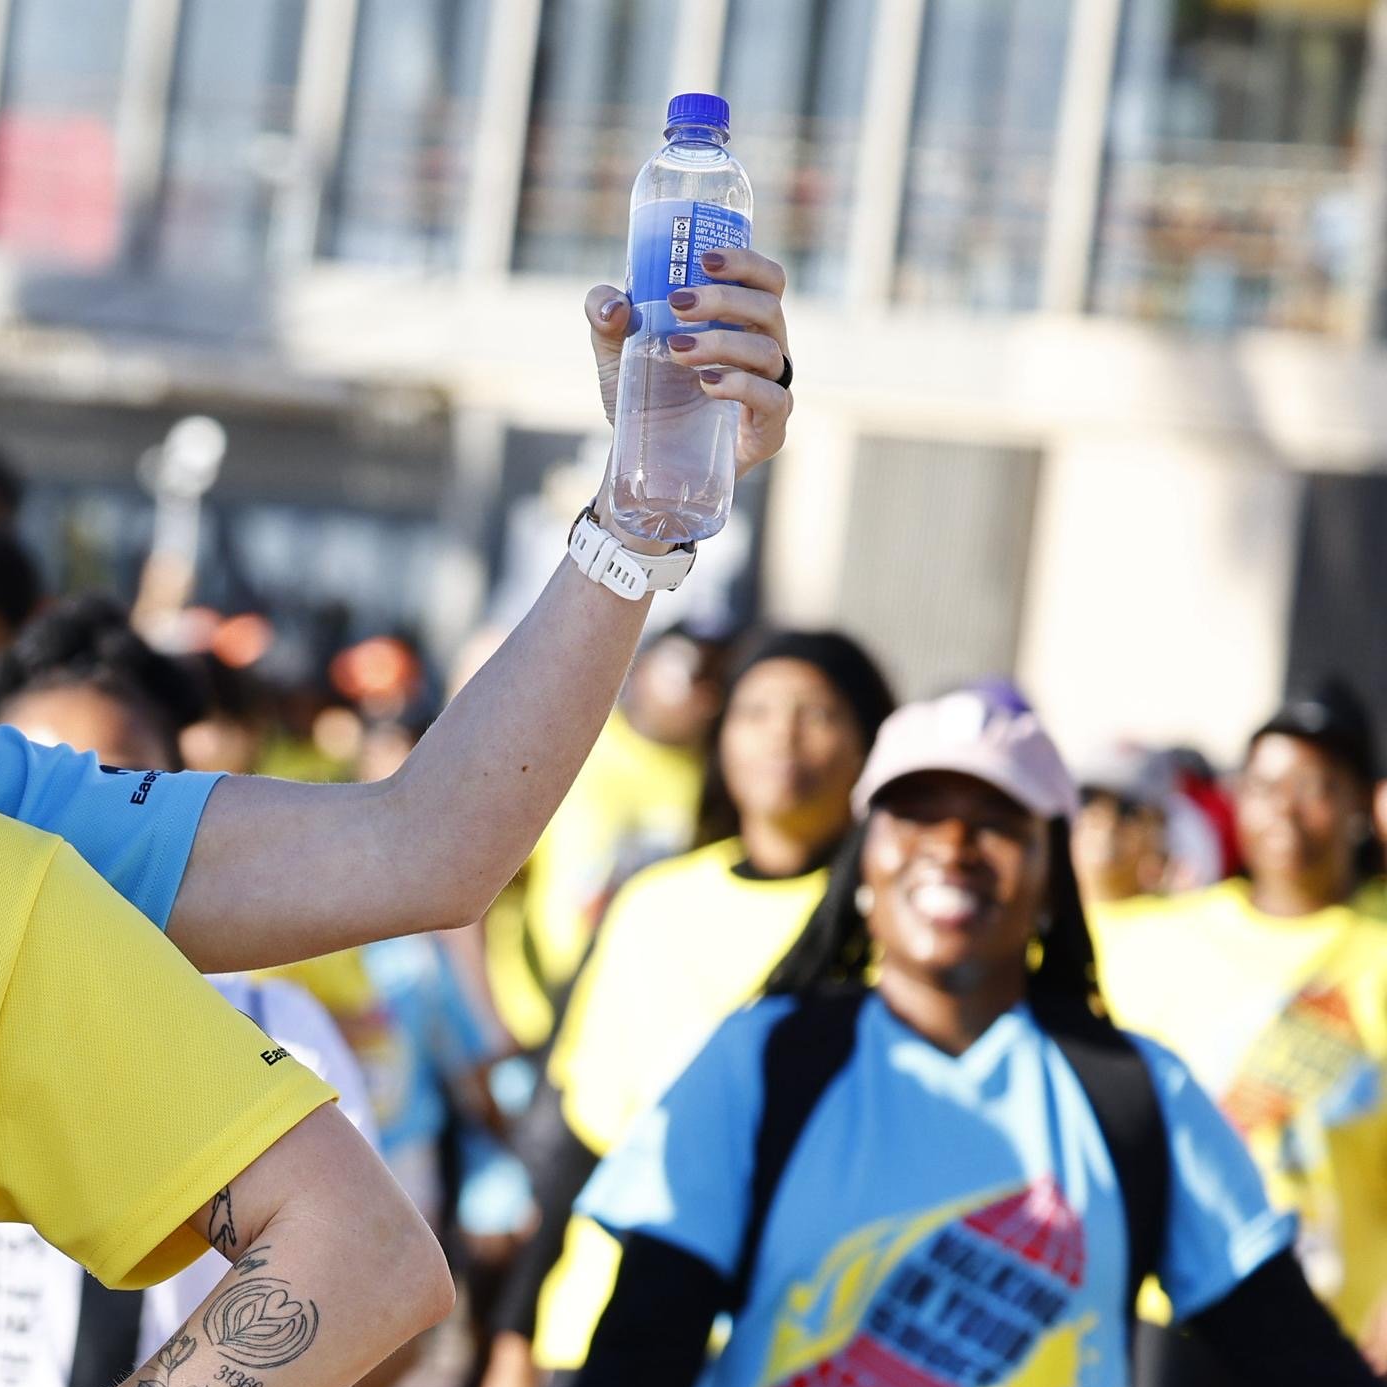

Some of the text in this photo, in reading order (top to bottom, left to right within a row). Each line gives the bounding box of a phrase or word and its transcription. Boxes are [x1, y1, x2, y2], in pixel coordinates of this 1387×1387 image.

[696, 219, 716, 229] STORE
[716, 223, 724, 231] IN
[694, 234, 717, 245] WITHIN
[695, 227, 709, 235] DRY
[709, 229, 728, 241] PLACE
